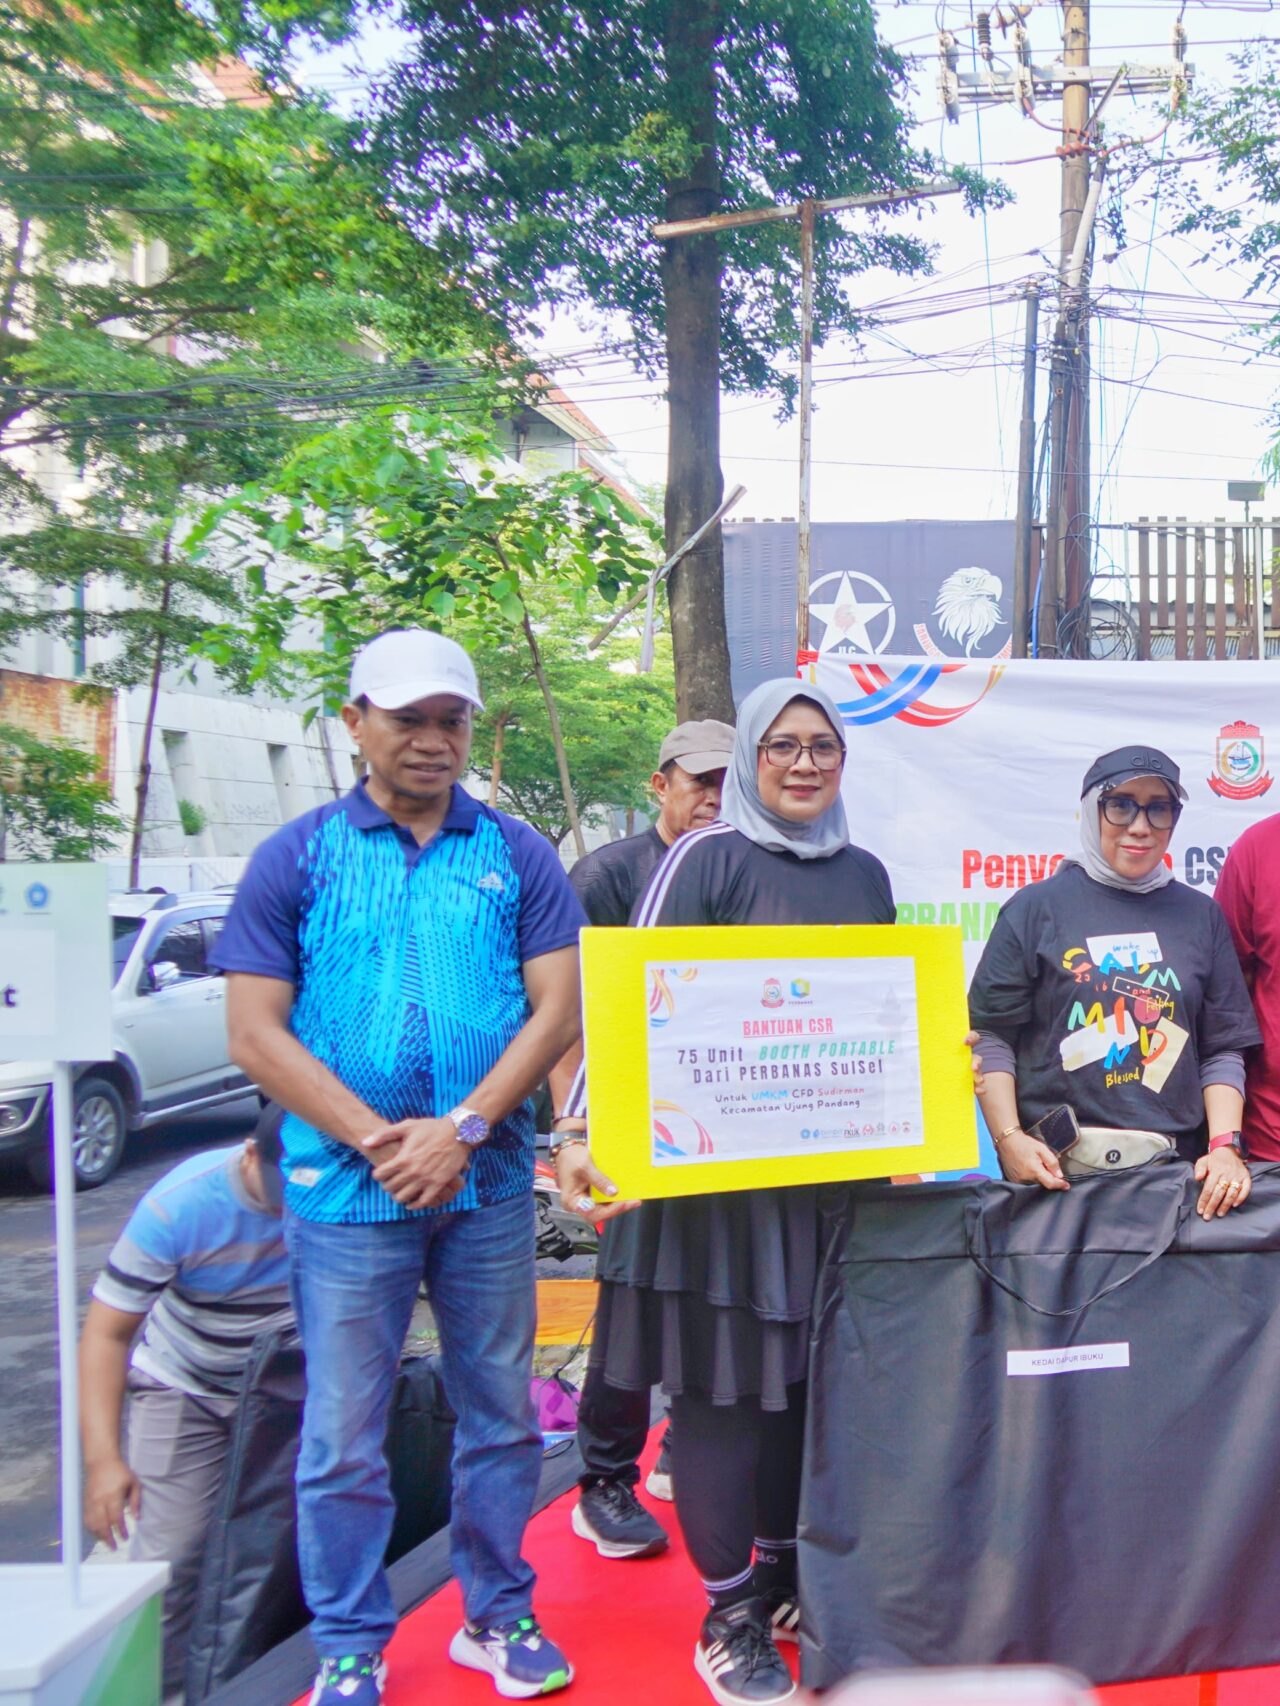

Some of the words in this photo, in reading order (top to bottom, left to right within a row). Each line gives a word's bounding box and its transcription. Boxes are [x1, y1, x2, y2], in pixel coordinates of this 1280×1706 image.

[1130, 752, 1163, 770] alo
[1185, 846, 1232, 886] CS
[743, 1018, 803, 1036] BANTUAN
[809, 1017, 834, 1034] CSR
[677, 1049, 698, 1065] 75
[708, 1046, 743, 1062] Unit
[758, 1043, 811, 1061] BOOTH
[819, 1040, 896, 1058] PORTABLE
[693, 1067, 730, 1084] Dari
[739, 1062, 822, 1081] PERBANAS
[831, 1058, 883, 1076] SulSel
[1105, 1066, 1140, 1089] Blessed
[715, 1093, 748, 1103] Untuk
[751, 1089, 789, 1101] UMKM
[791, 1088, 814, 1099] CFD
[817, 1086, 865, 1097] Sudirman
[720, 1104, 781, 1115] Kecamatan
[784, 1102, 814, 1113] Ujung
[817, 1099, 861, 1110] Pandang
[1031, 1358, 1055, 1367] KEDAI
[1056, 1355, 1078, 1364] DAPUR
[1080, 1353, 1104, 1362] IBUKU
